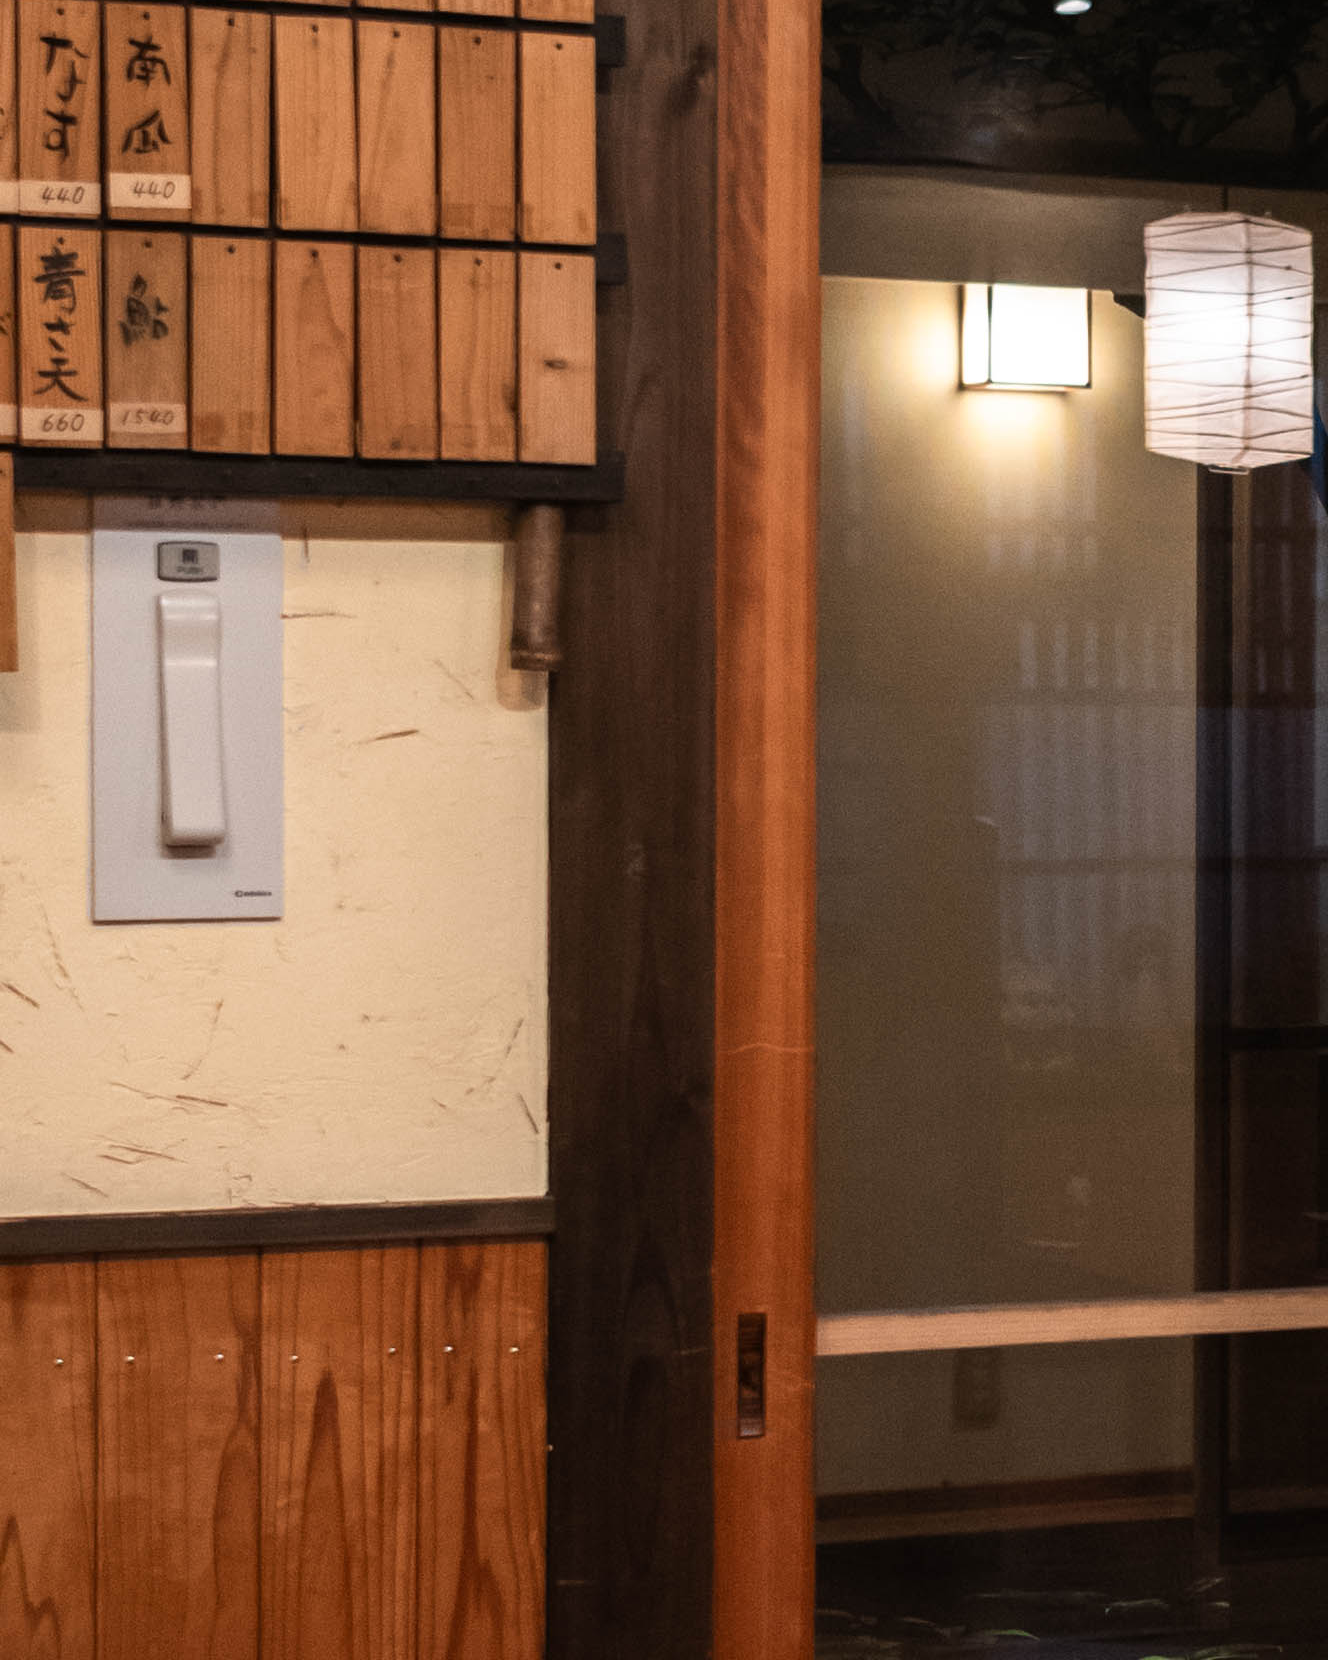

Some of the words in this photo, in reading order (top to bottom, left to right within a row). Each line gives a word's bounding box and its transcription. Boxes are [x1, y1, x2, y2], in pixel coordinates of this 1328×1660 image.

[40, 32, 89, 163] なす
[122, 36, 172, 155] 南瓜
[42, 186, 85, 205] 440
[133, 181, 176, 200] 440
[42, 413, 85, 433] 660
